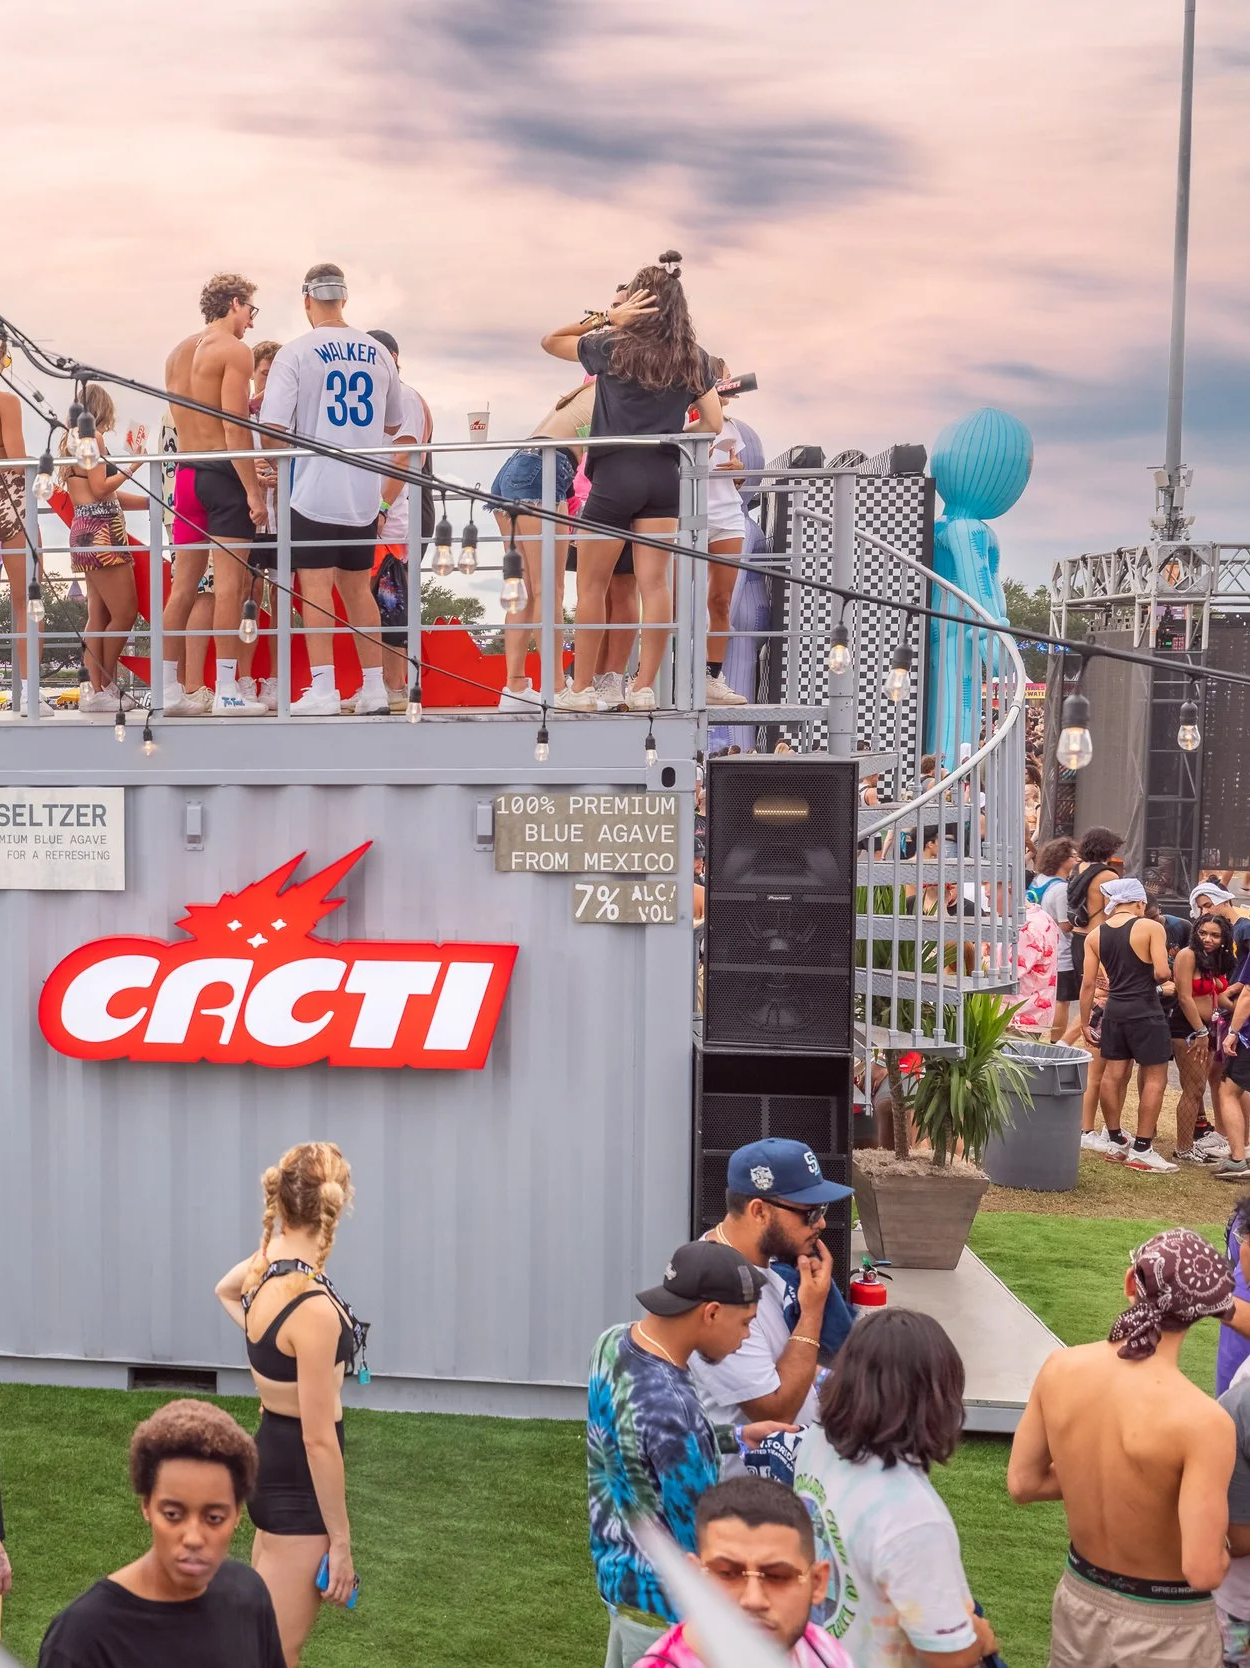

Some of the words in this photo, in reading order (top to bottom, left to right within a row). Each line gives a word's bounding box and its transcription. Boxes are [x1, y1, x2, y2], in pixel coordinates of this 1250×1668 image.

[314, 341, 376, 365] WALKER
[326, 370, 374, 427] 33
[496, 796, 556, 815] 100%
[569, 796, 676, 815] PREMIUM
[34, 835, 63, 844] BLUE
[70, 835, 107, 845] AGAVE
[525, 823, 584, 842] BLUE
[597, 824, 675, 843] AGAVE
[7, 850, 26, 859] FOR
[32, 850, 39, 859] A
[45, 850, 110, 860] REFRESHING
[511, 851, 569, 870] FROM
[584, 852, 674, 872] MEXICO
[574, 883, 620, 921] 7%
[638, 904, 673, 923] VOL
[60, 954, 495, 1051] CACTI
